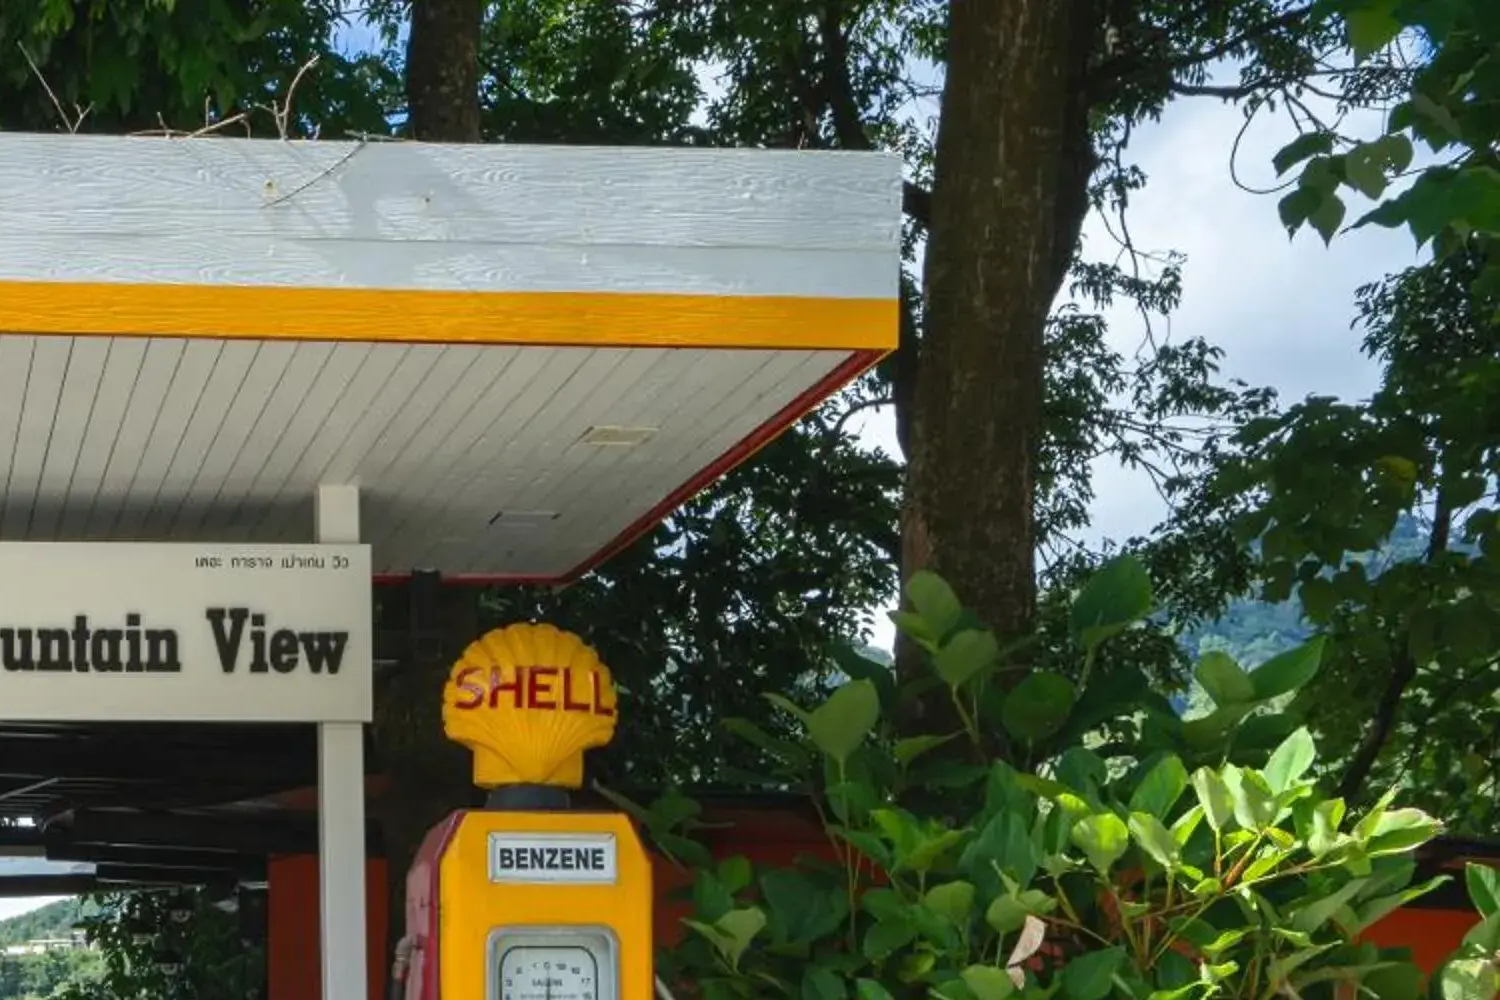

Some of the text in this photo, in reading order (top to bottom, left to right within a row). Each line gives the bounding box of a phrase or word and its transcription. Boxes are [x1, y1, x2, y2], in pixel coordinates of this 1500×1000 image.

[206, 607, 349, 675] View
[453, 666, 614, 717] SHELL
[499, 847, 606, 870] BENZENE
